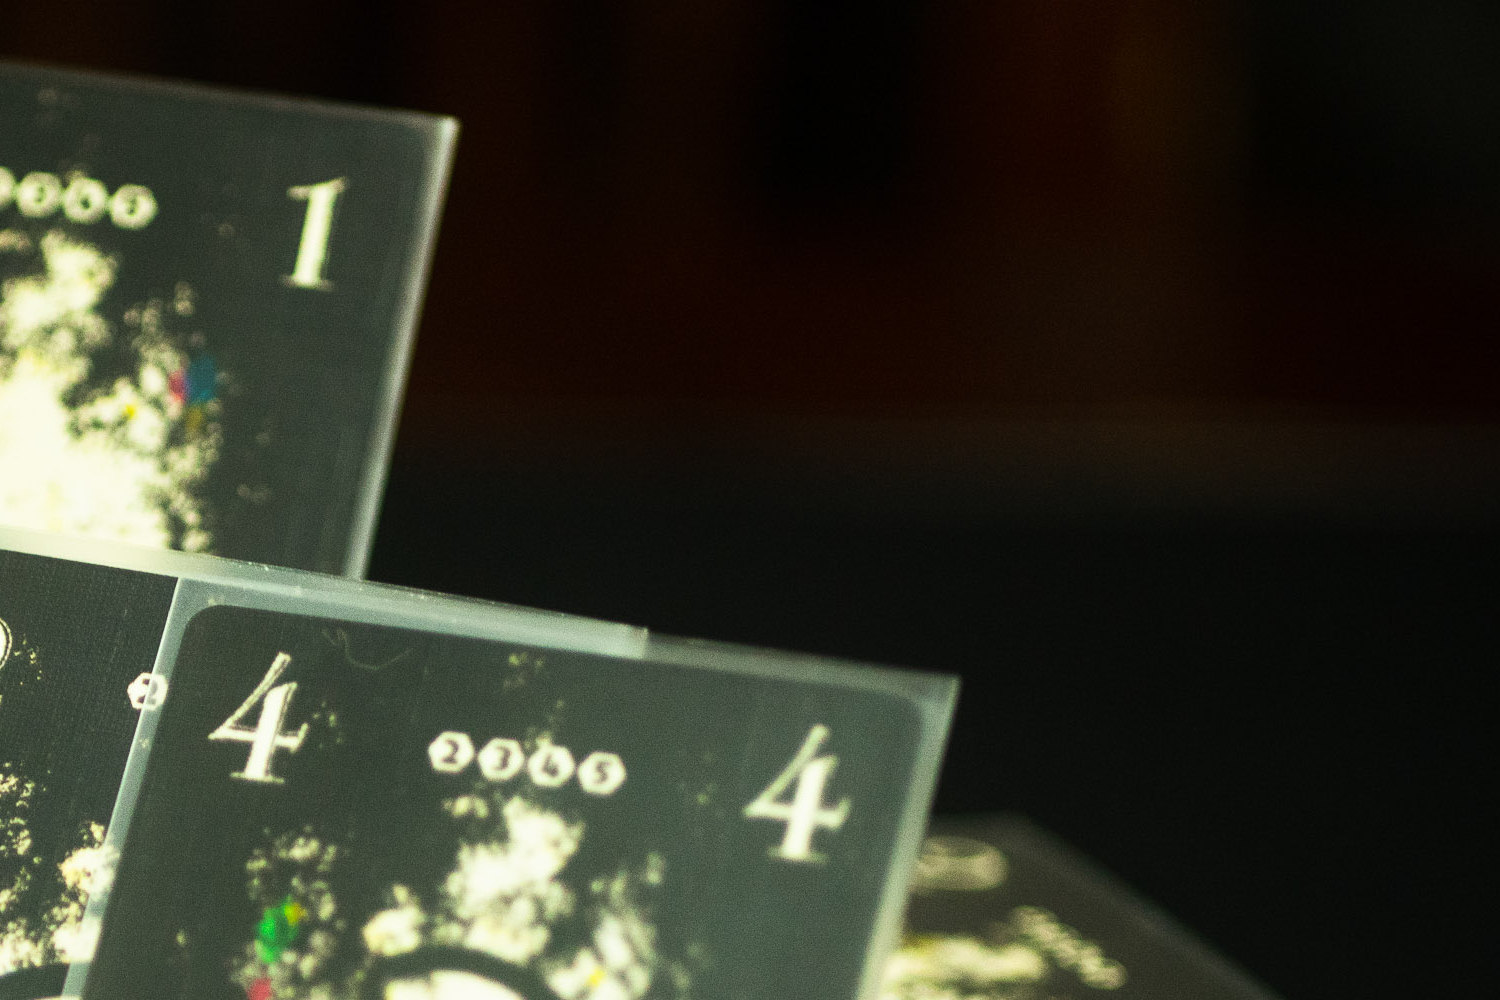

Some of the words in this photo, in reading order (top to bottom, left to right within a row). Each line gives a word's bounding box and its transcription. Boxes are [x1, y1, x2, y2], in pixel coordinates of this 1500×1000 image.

[287, 177, 347, 290] 1
[208, 652, 309, 783] 4
[744, 724, 850, 862] 4
